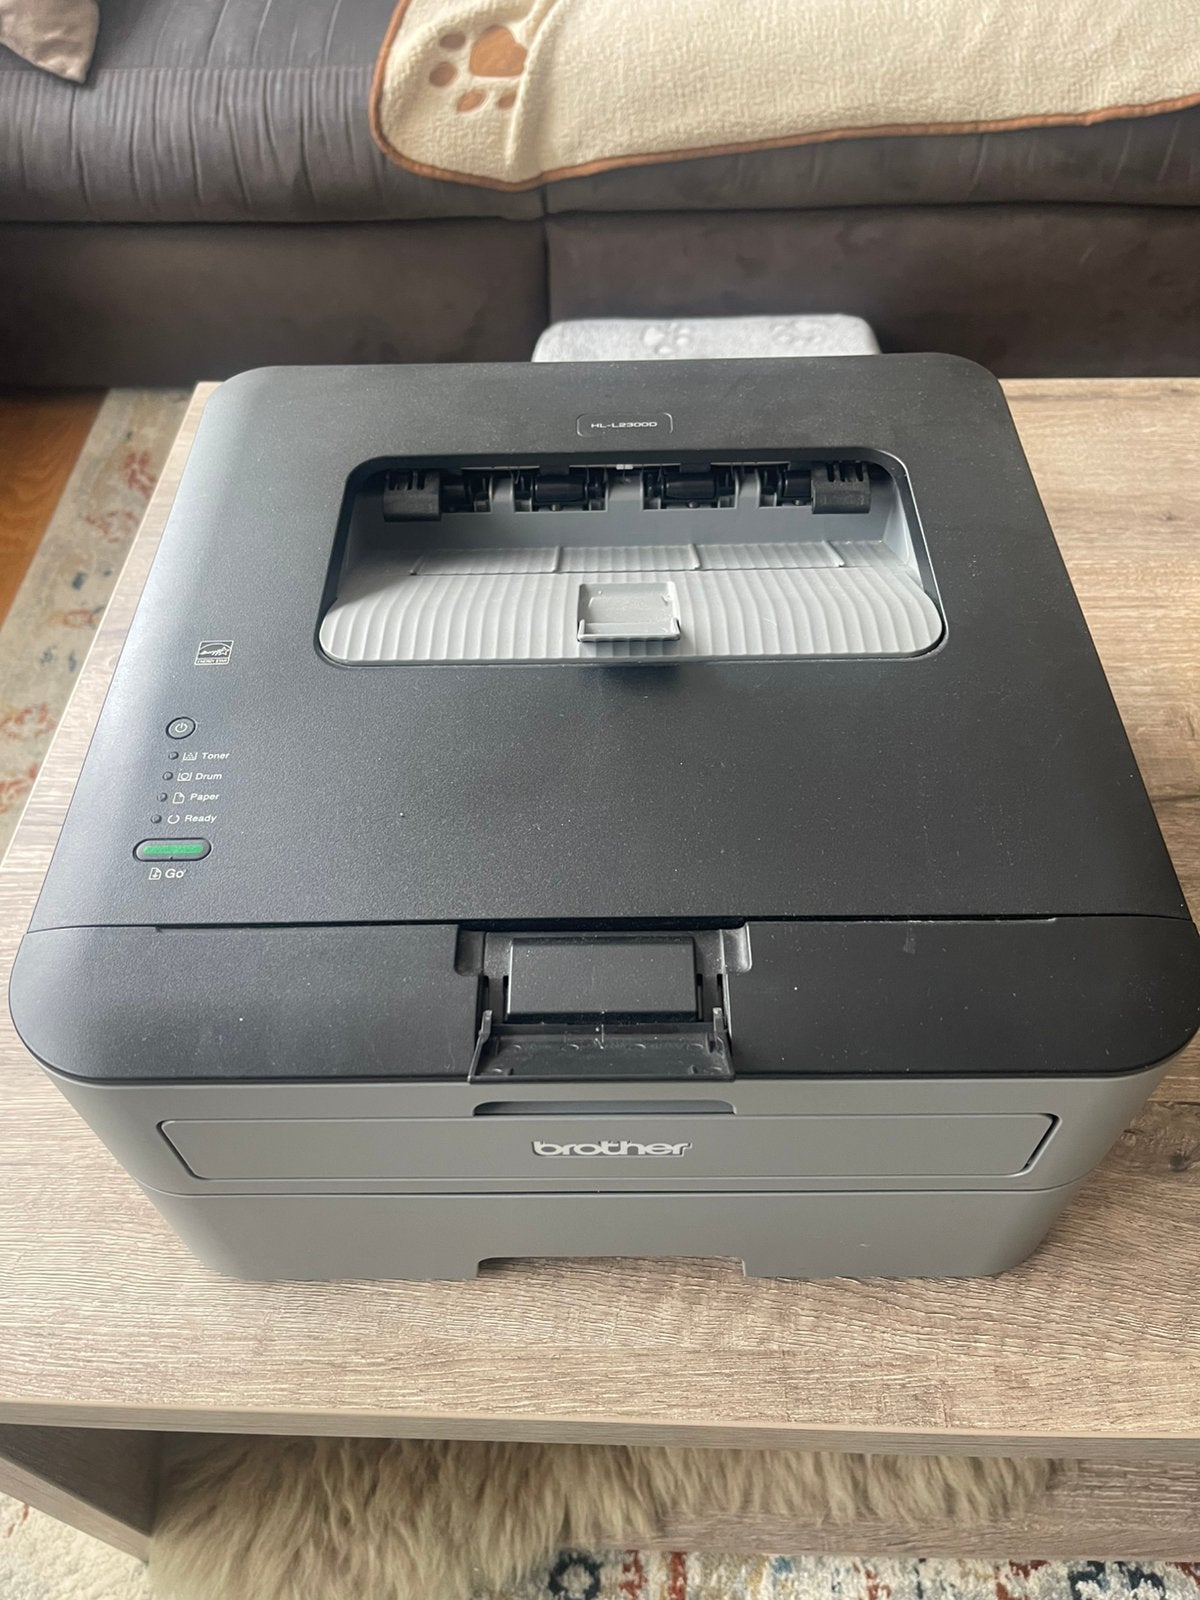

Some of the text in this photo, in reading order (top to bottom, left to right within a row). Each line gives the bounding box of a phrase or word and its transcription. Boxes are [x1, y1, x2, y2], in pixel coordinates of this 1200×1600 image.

[590, 421, 658, 429] HL-L2300D
[201, 751, 230, 760] Toner
[195, 772, 222, 781] Drum
[189, 792, 220, 802] Paper
[184, 814, 218, 824] Ready
[164, 867, 186, 879] Go
[532, 1140, 692, 1157] brother
